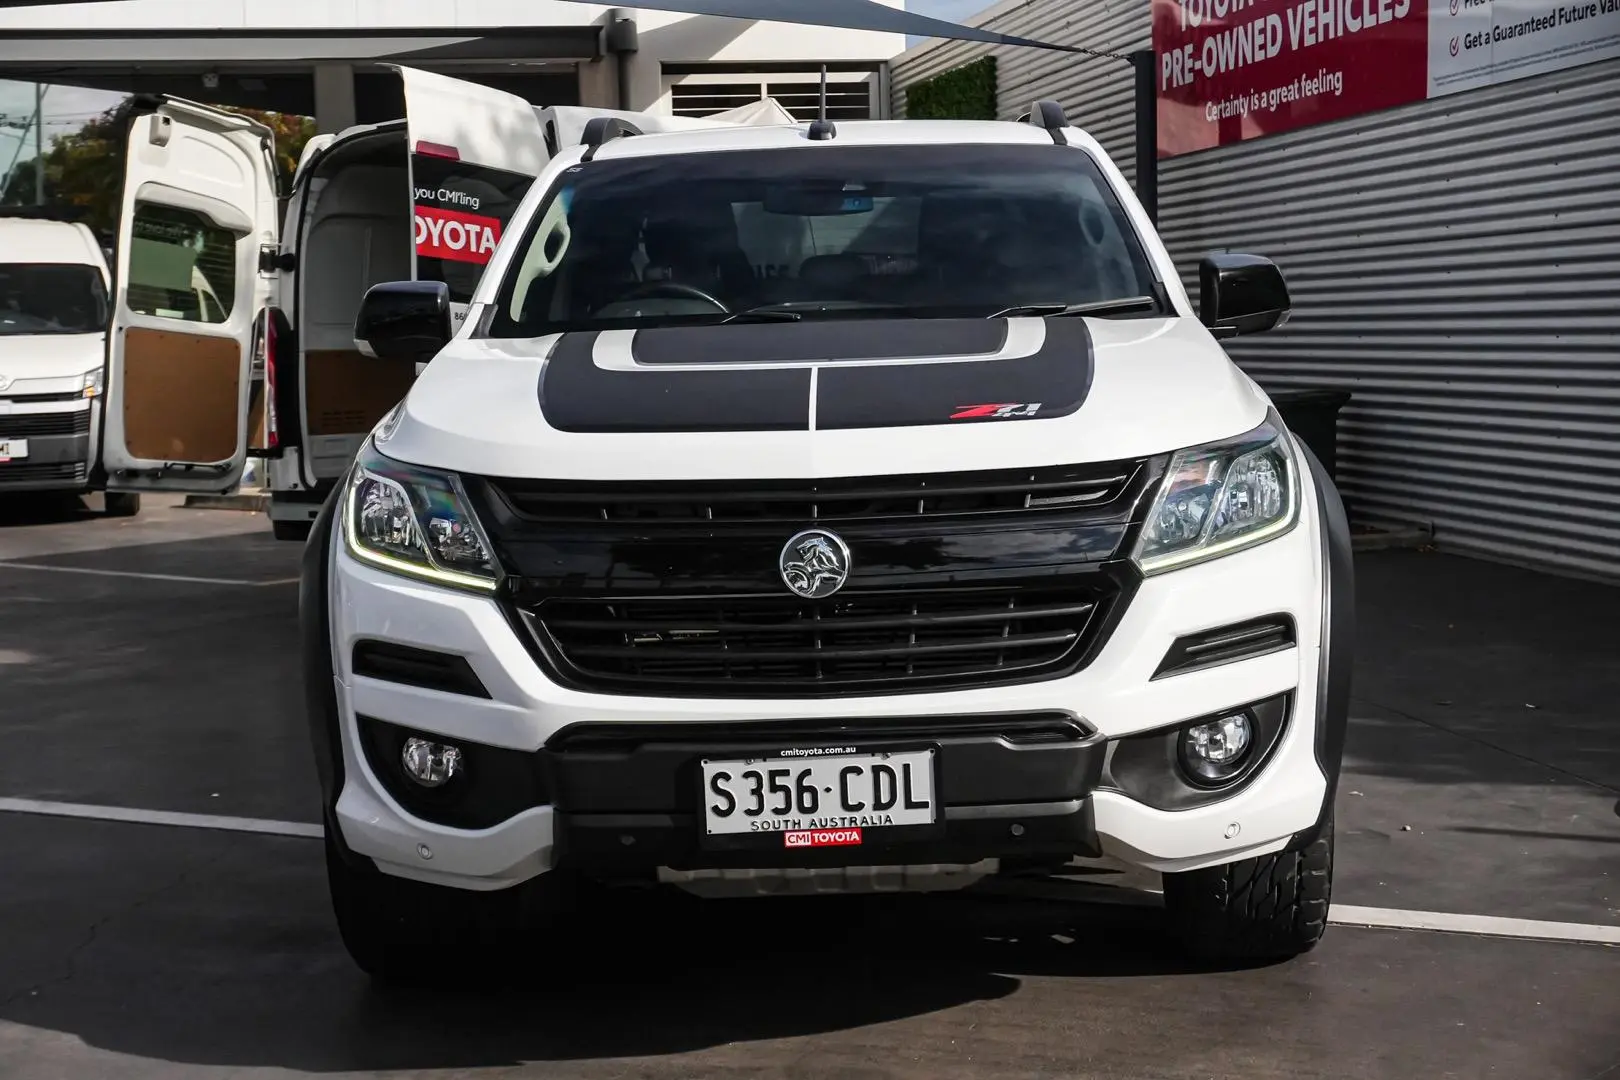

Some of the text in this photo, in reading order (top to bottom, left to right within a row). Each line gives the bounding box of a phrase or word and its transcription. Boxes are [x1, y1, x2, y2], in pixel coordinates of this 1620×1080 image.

[1179, 0, 1254, 32] TOYO
[1464, 0, 1620, 50] Get a Guaranteed Future Val
[1162, 13, 1283, 91] PRE-OWNED
[1205, 68, 1343, 121] Certainty is a great feeling
[414, 187, 435, 200] you
[780, 747, 857, 757] cmitoyota.com.au
[751, 814, 894, 831] SOUTH AUSTRALIA
[787, 831, 860, 844] CMI TOYOTA
